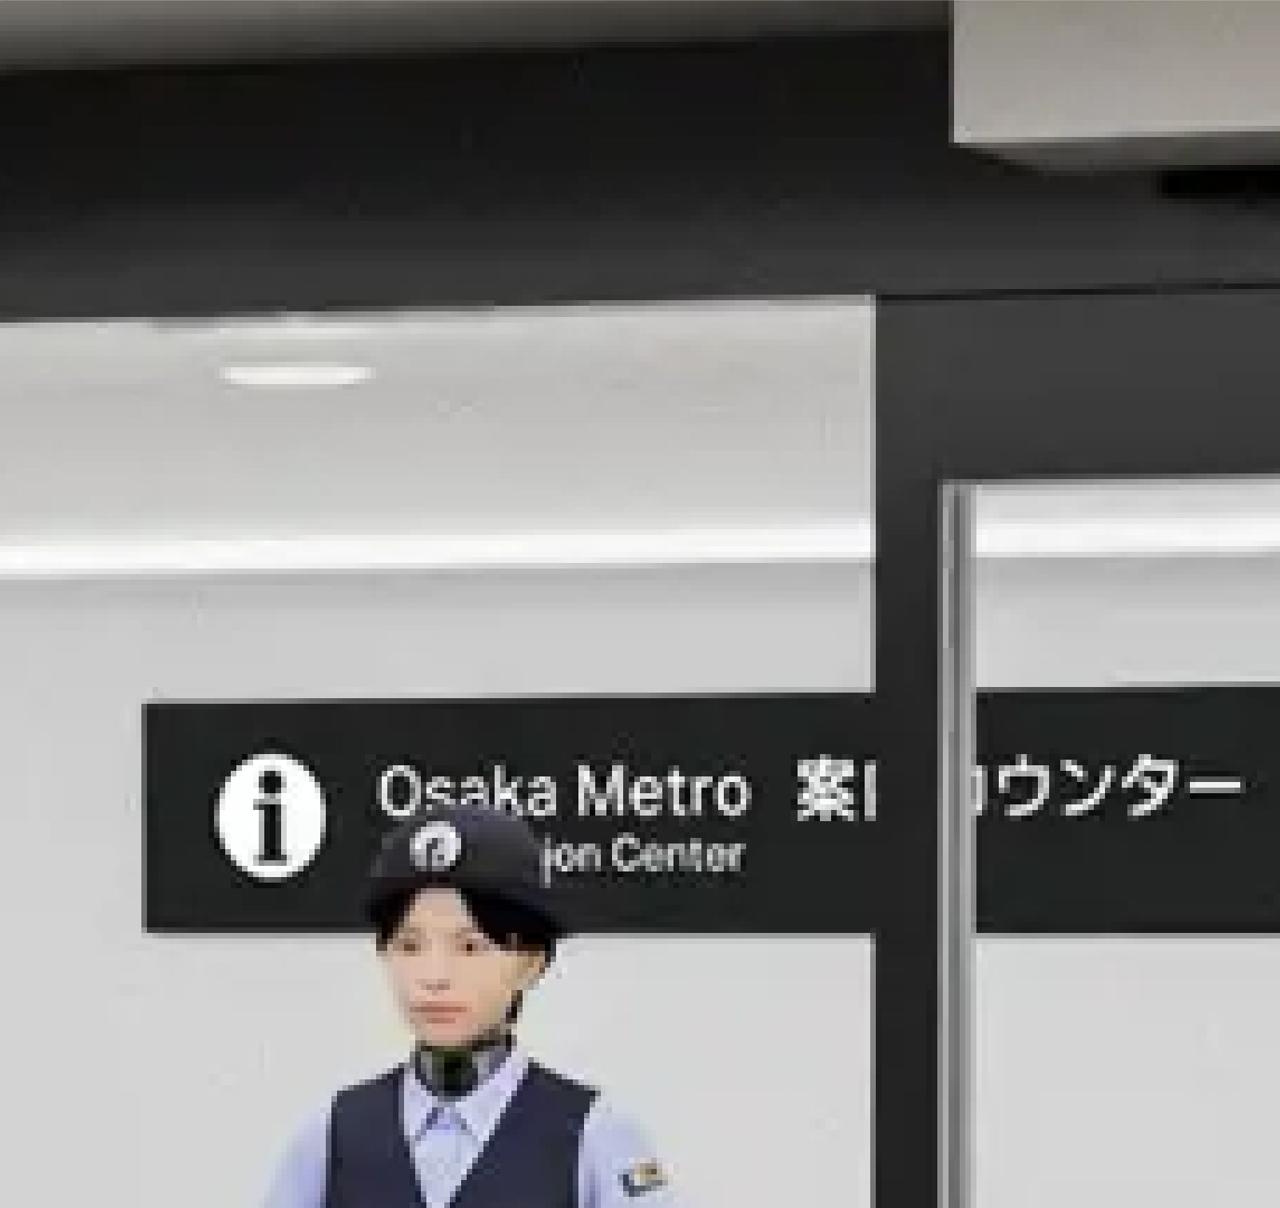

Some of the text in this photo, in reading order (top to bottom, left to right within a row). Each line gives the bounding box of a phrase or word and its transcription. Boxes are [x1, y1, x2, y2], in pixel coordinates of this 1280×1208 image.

[377, 753, 1246, 823] Osaka Metro 案ウンター
[610, 834, 745, 873] Center
